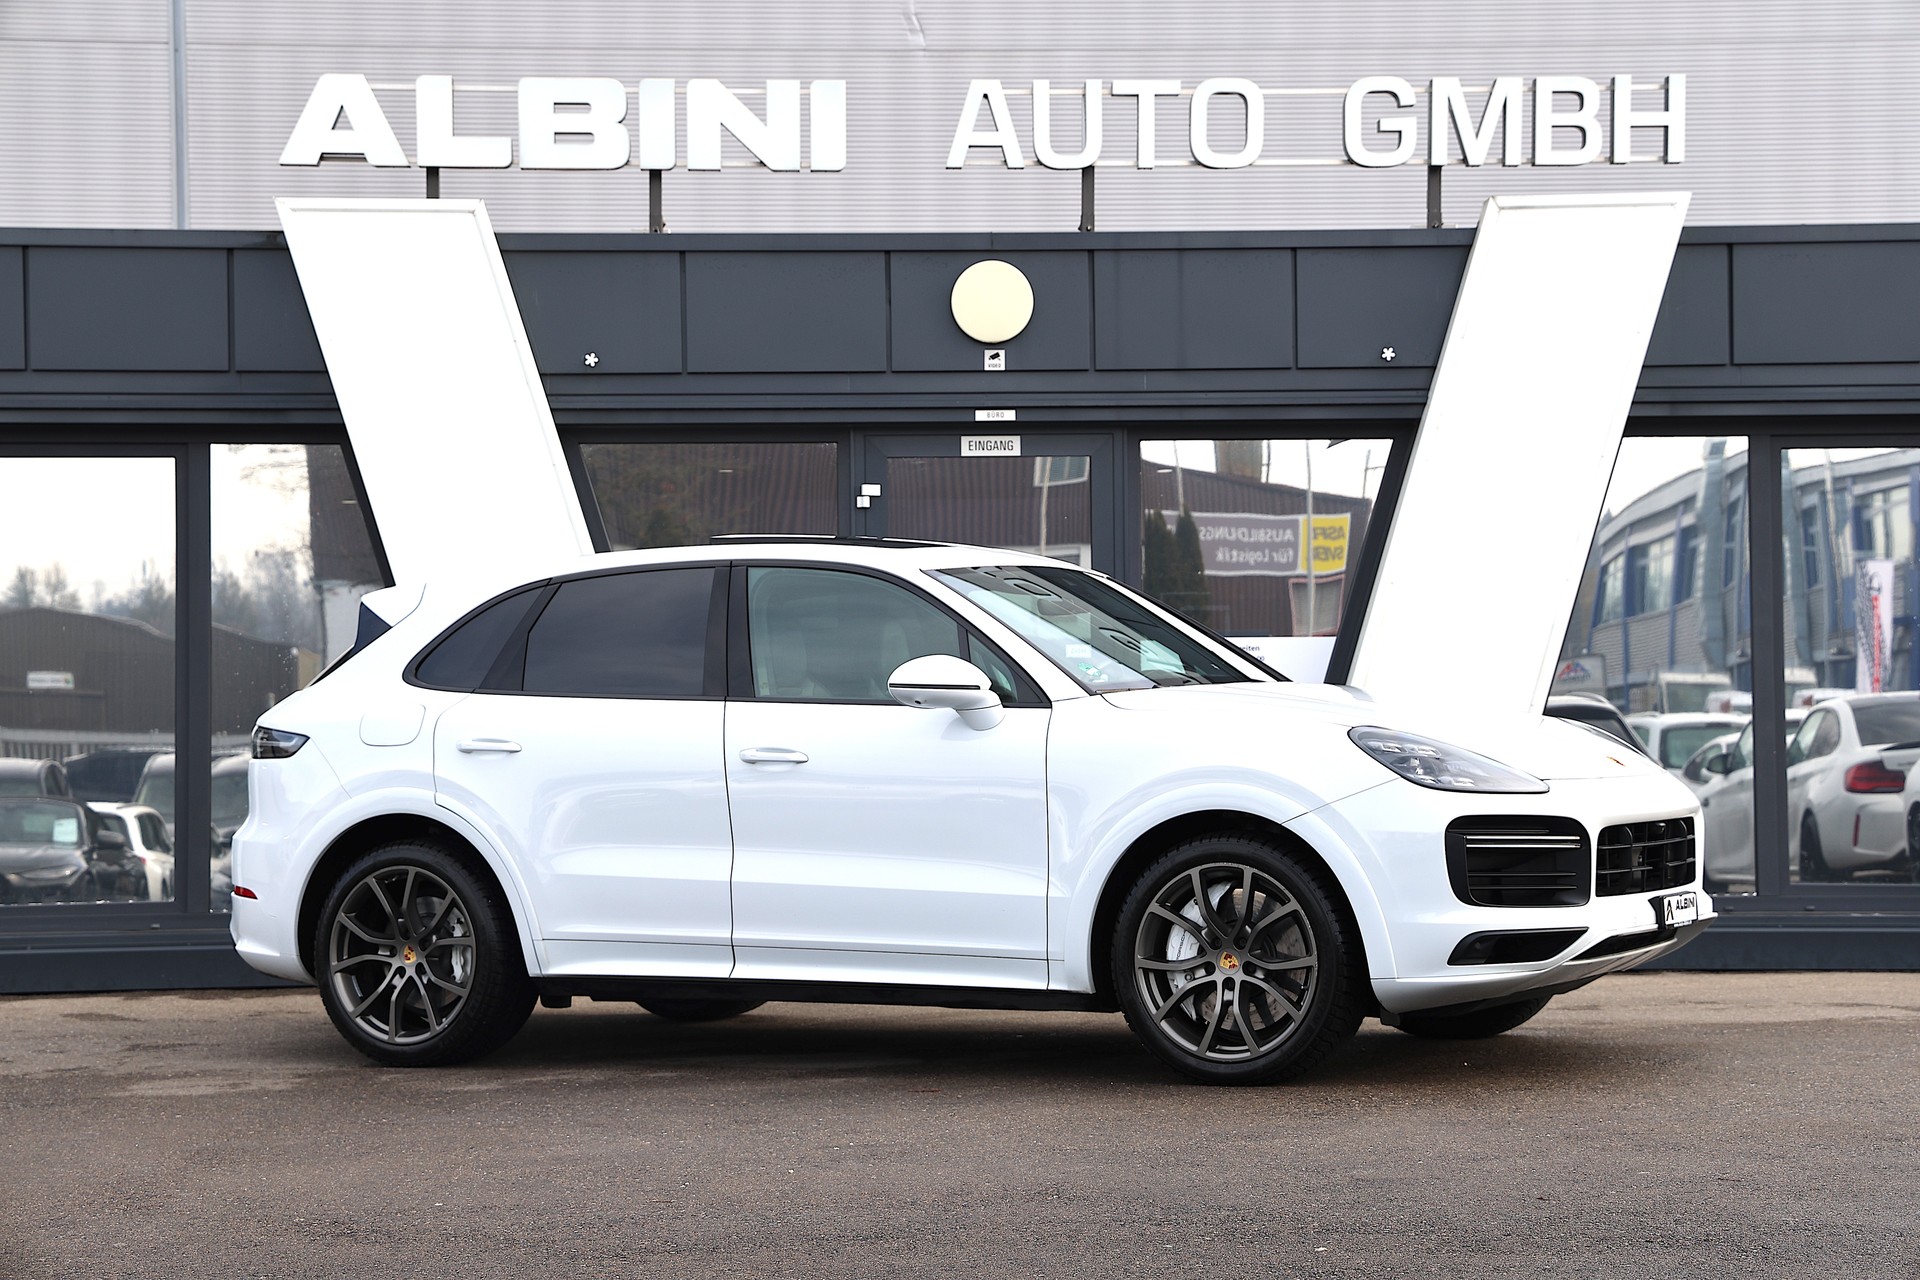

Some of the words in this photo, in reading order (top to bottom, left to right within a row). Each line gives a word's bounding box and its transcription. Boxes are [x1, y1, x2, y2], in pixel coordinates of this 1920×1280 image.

[279, 73, 846, 172] ALBINI
[945, 76, 1265, 170] AUTO
[1342, 73, 1687, 167] GMBH
[968, 440, 1014, 451] EINGANG
